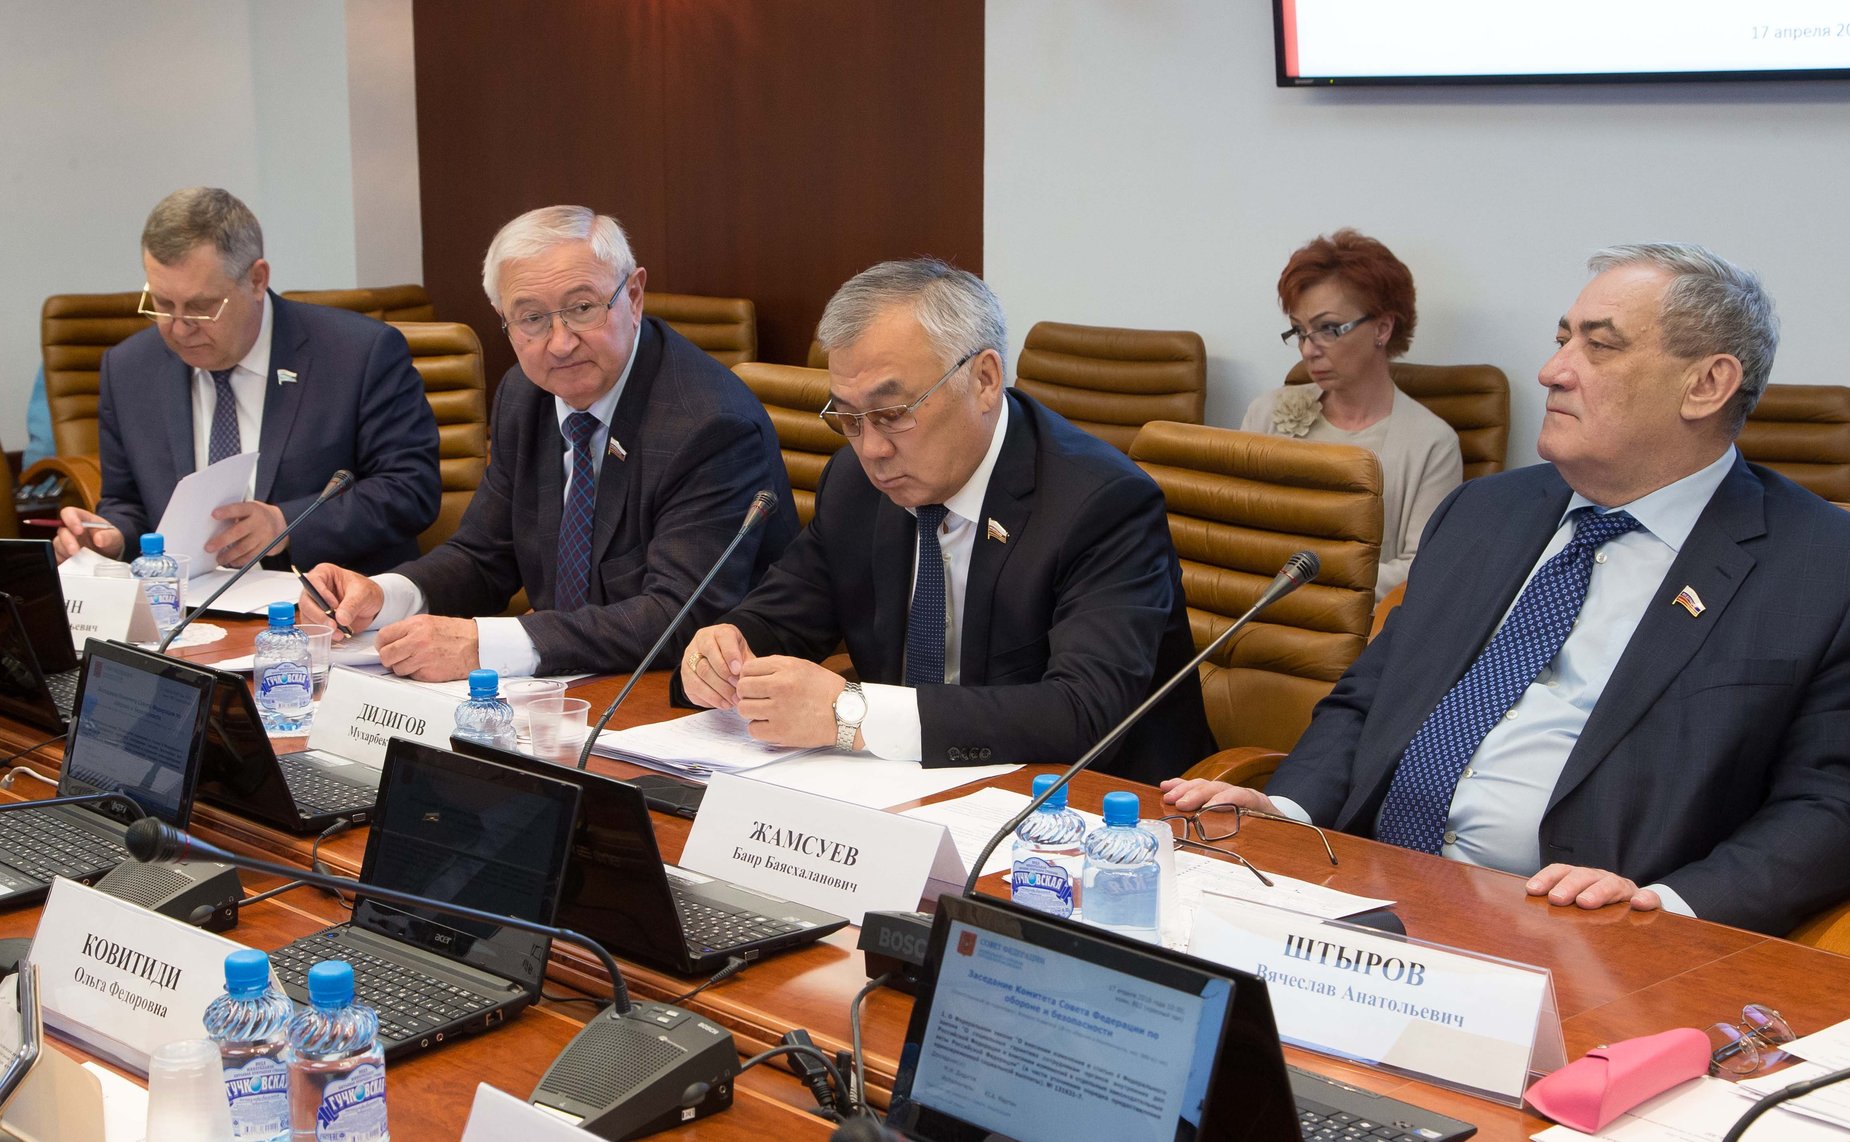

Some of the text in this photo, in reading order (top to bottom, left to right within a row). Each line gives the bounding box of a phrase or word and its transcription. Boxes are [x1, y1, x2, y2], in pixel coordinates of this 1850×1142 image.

[1752, 25, 1769, 39] 17
[1774, 26, 1831, 40] апреля
[348, 725, 388, 747] Мухарбек
[356, 703, 427, 736] ДИДИГОВ
[749, 820, 859, 867] ЖАМСУЕВ
[732, 846, 858, 893] Баир Баясхаланович
[82, 933, 182, 991] КОВИТИДИ
[434, 933, 452, 944] acer
[879, 926, 927, 959] BOSC
[1283, 934, 1426, 986] ШТЫРОВ
[74, 966, 168, 1018] Ольга Федоровна
[1256, 963, 1464, 1027] Вячеслав Анатольевич
